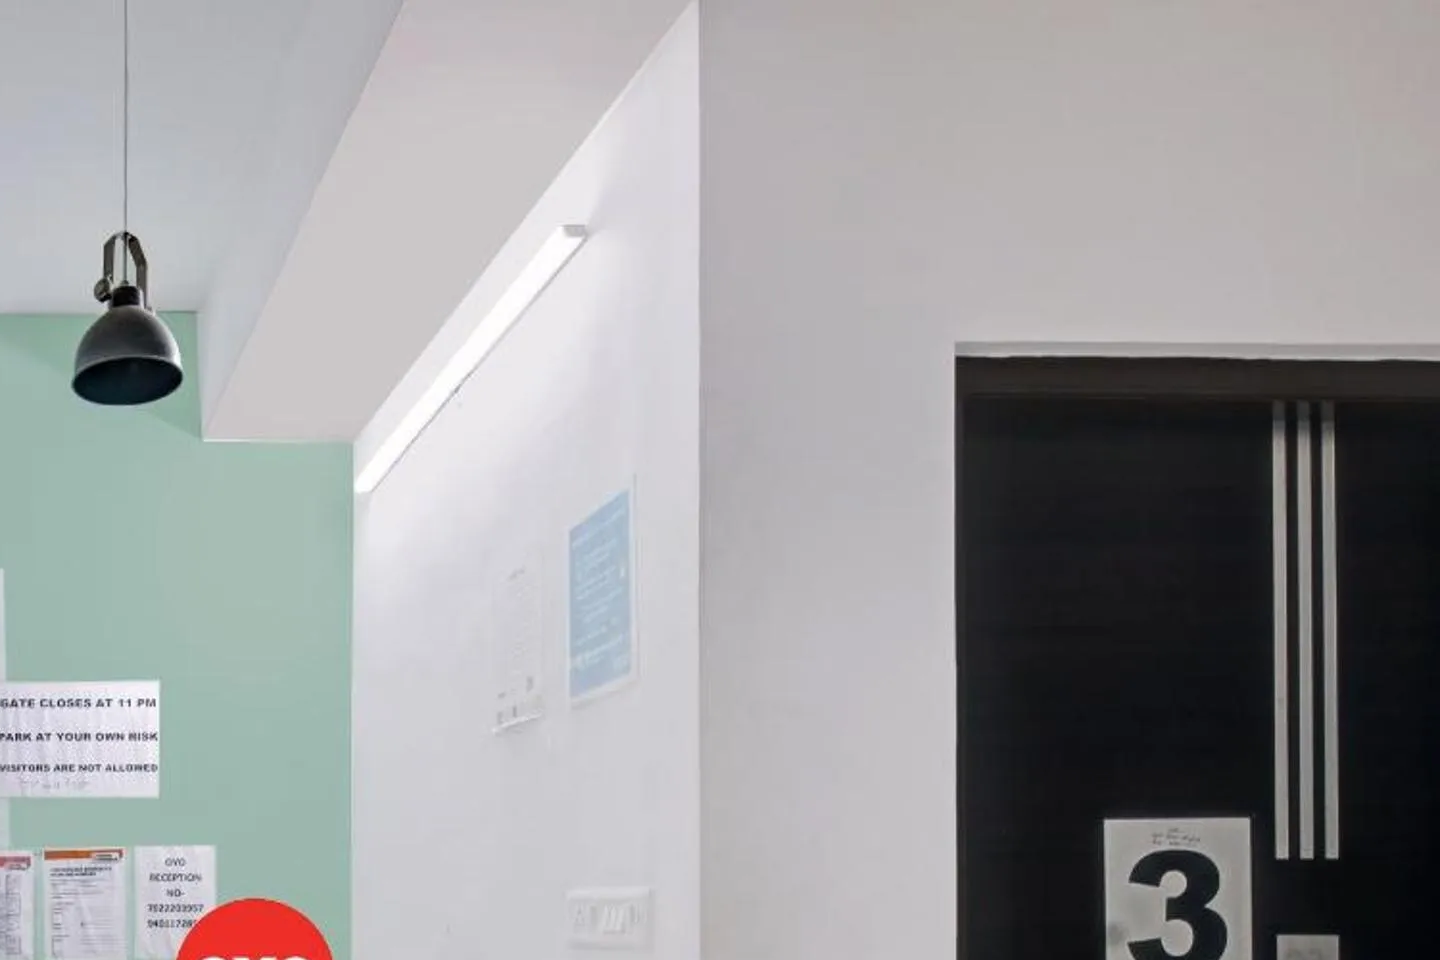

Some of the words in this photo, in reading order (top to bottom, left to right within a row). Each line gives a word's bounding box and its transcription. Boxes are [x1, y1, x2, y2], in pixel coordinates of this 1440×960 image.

[0, 697, 36, 709] GATE
[39, 698, 92, 708] CLOSES
[95, 698, 113, 708] AT
[118, 698, 132, 708] 11
[136, 698, 157, 708] PM
[35, 732, 52, 742] AT
[56, 732, 92, 742] YOUR
[95, 732, 125, 742] OWN
[128, 732, 158, 742] RISK
[53, 763, 76, 773] ARE
[78, 763, 102, 773] NOT
[105, 763, 158, 773] ALLOWED
[164, 857, 187, 867] OYO
[149, 872, 203, 882] RECEPTION
